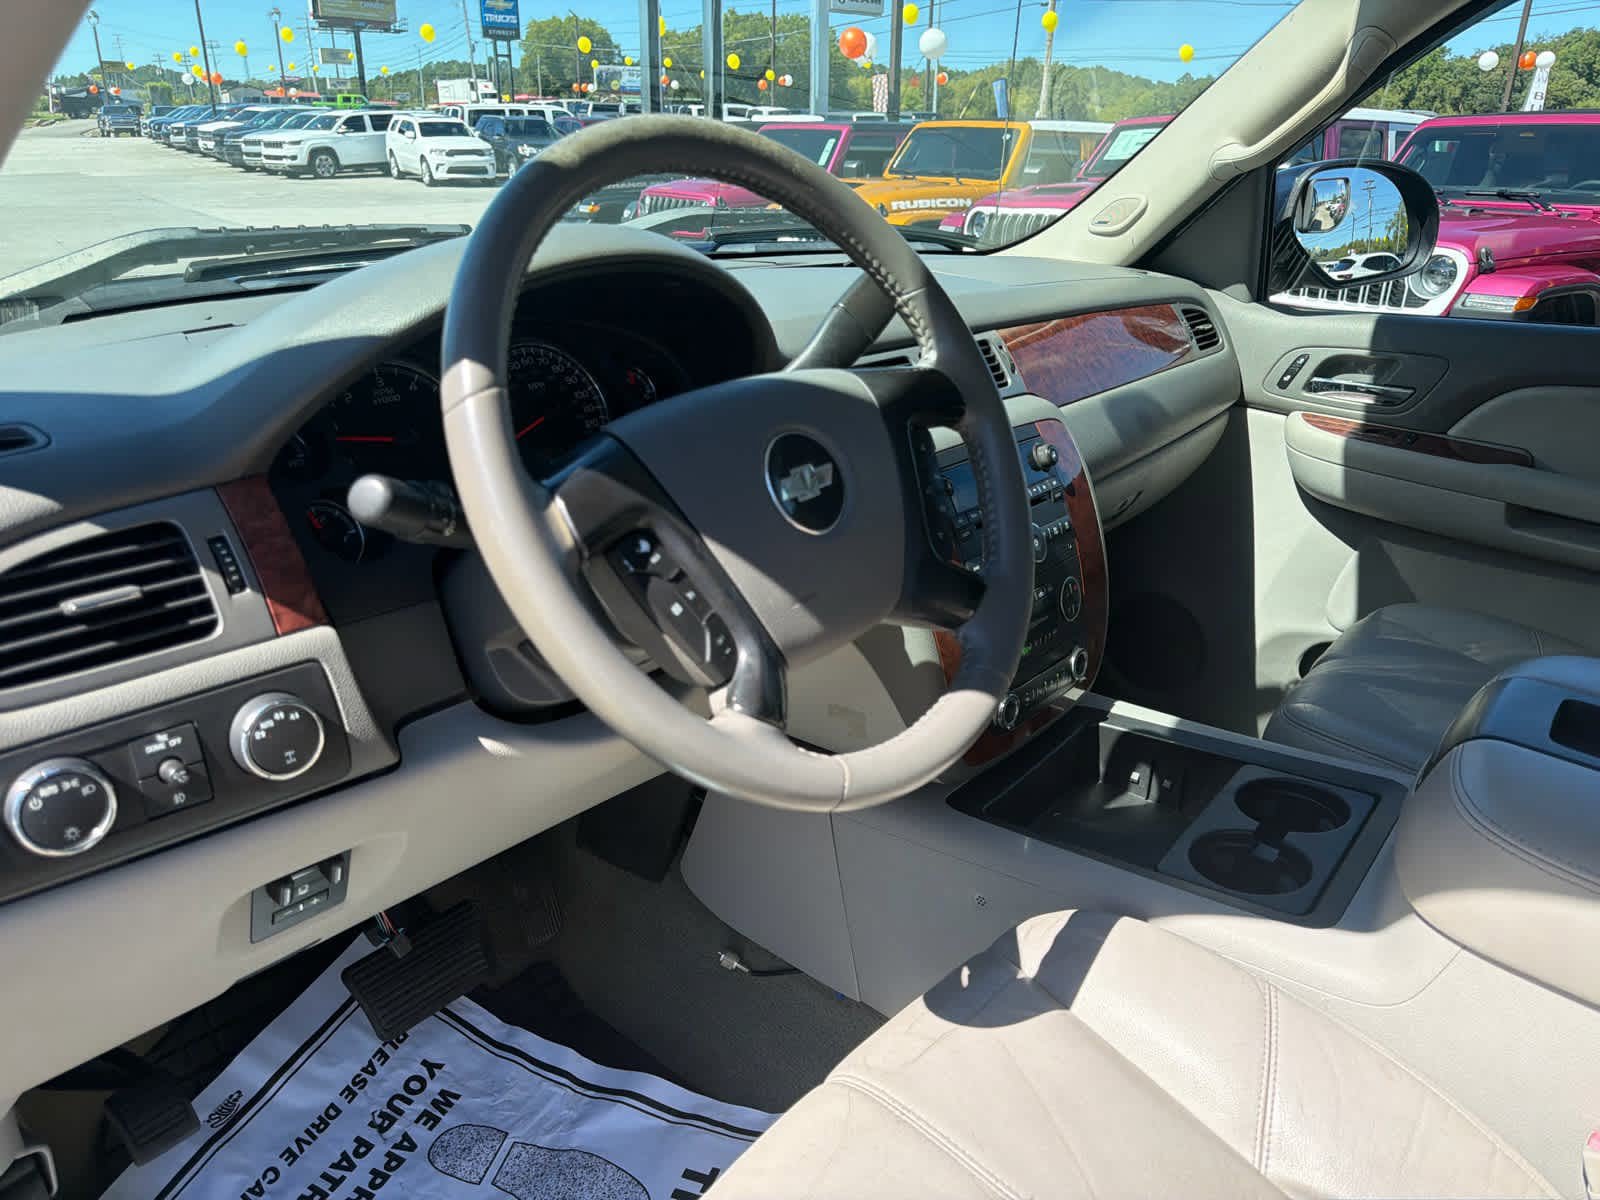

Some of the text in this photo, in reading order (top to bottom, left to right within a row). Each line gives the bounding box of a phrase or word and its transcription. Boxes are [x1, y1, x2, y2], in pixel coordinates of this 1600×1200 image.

[484, 13, 518, 24] TRUCKS
[890, 198, 973, 211] RUBICON
[339, 1032, 409, 1104] PLEASE
[367, 1058, 446, 1136] YOUR
[414, 1088, 462, 1131] WE
[279, 1102, 343, 1167] DRIVE
